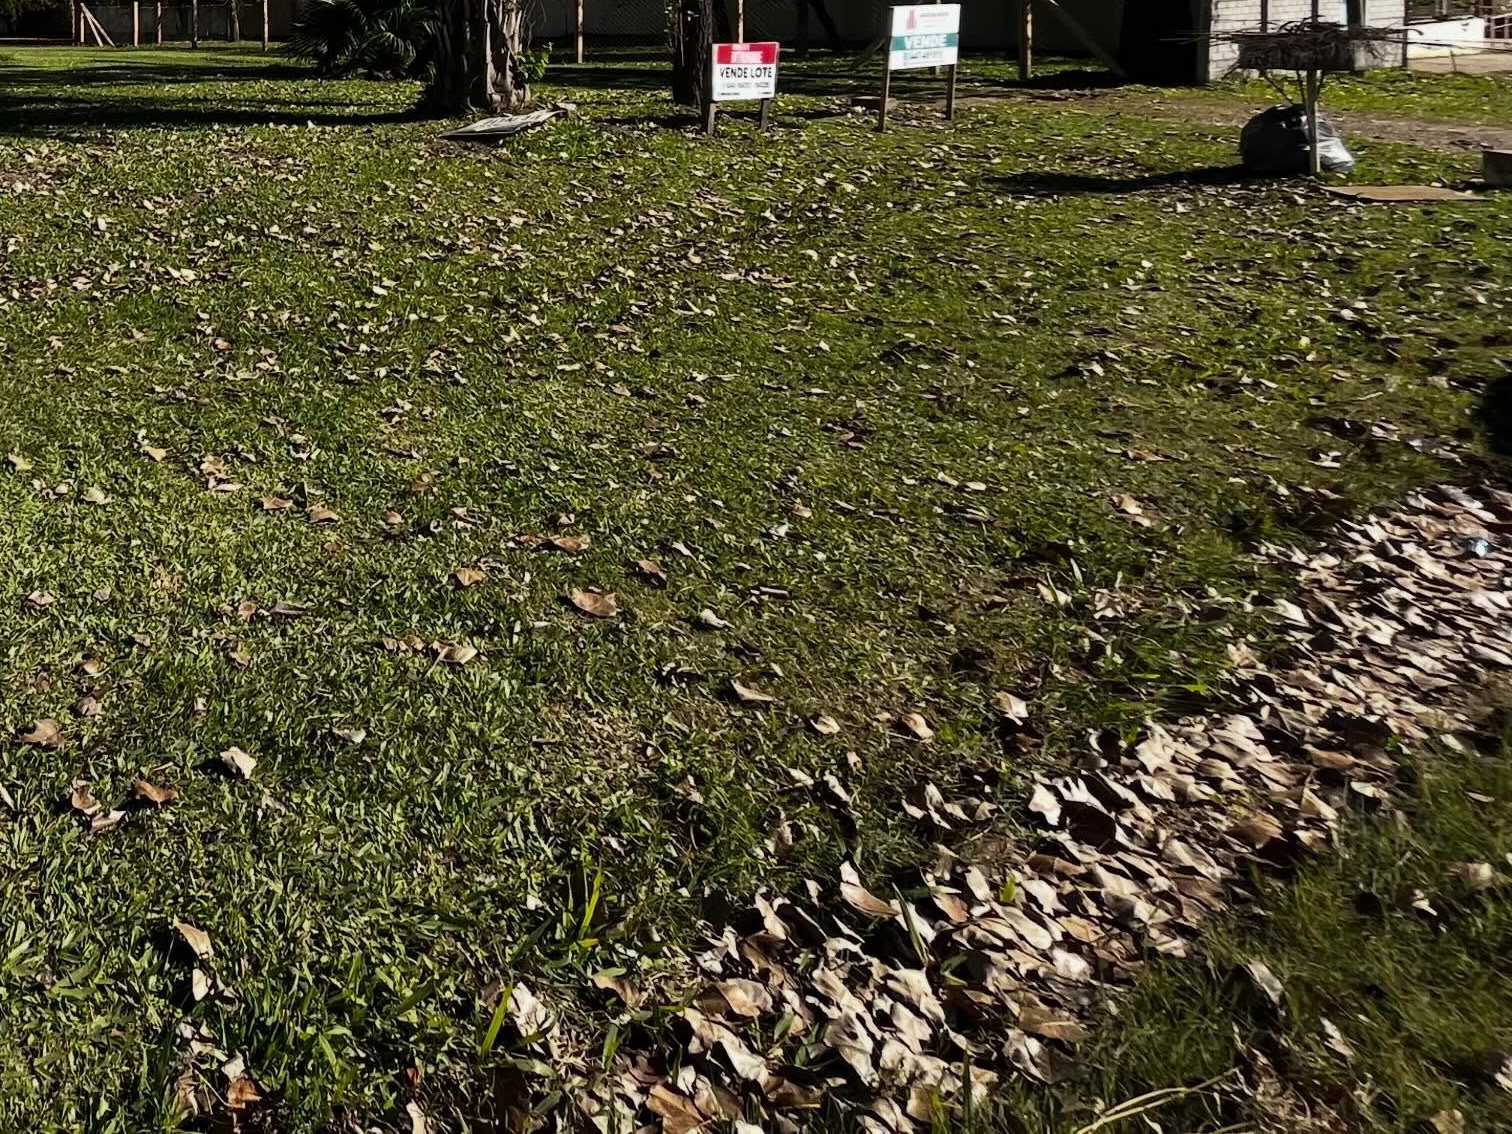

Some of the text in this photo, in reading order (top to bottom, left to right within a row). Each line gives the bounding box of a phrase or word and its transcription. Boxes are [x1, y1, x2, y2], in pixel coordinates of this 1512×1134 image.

[904, 34, 947, 50] VENDE
[719, 66, 772, 79] VENDE LOTE
